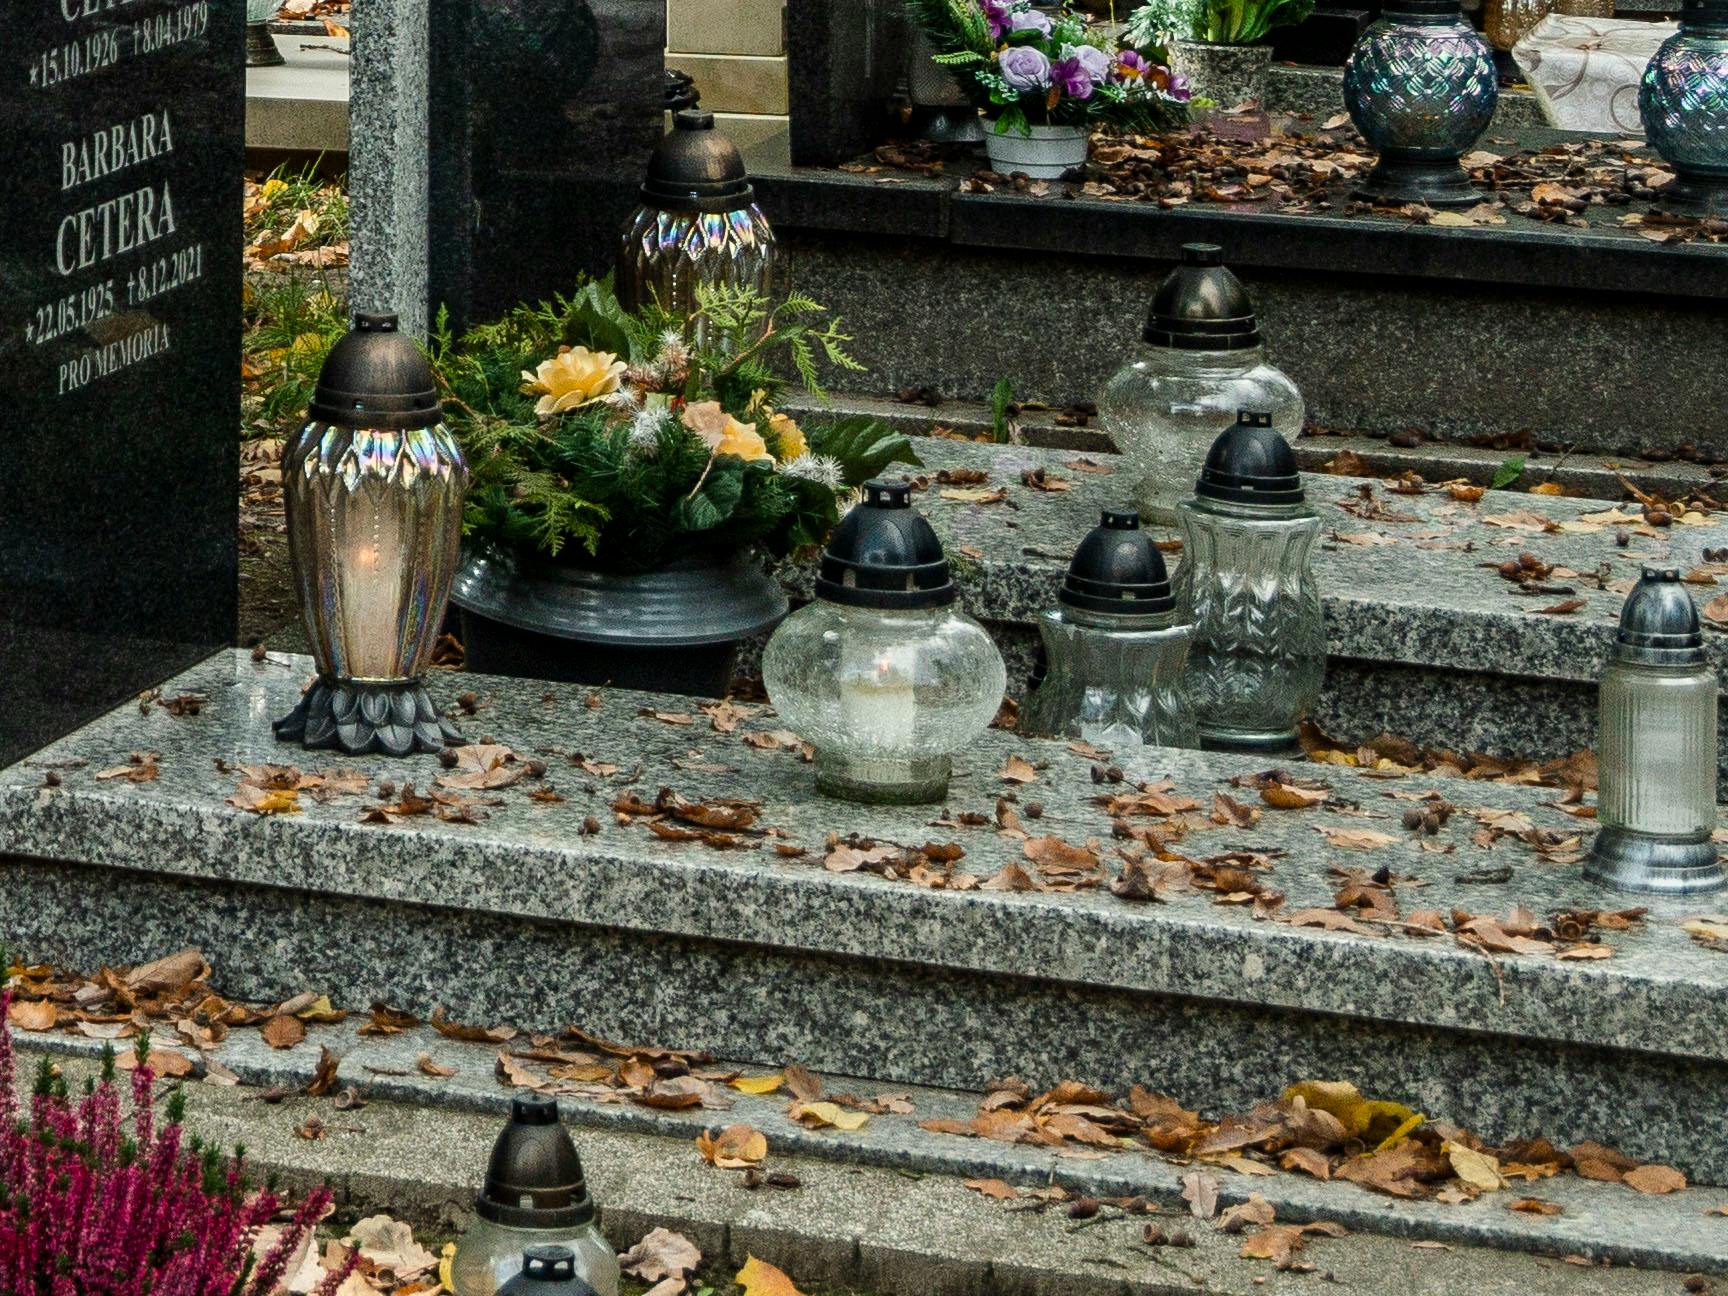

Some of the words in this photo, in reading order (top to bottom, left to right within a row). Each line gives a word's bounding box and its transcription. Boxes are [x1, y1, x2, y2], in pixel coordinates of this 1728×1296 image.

[60, 108, 174, 191] BARBARA
[55, 179, 177, 277] CETERA
[58, 352, 91, 396] PRO
[94, 322, 171, 380] MEMORIA
